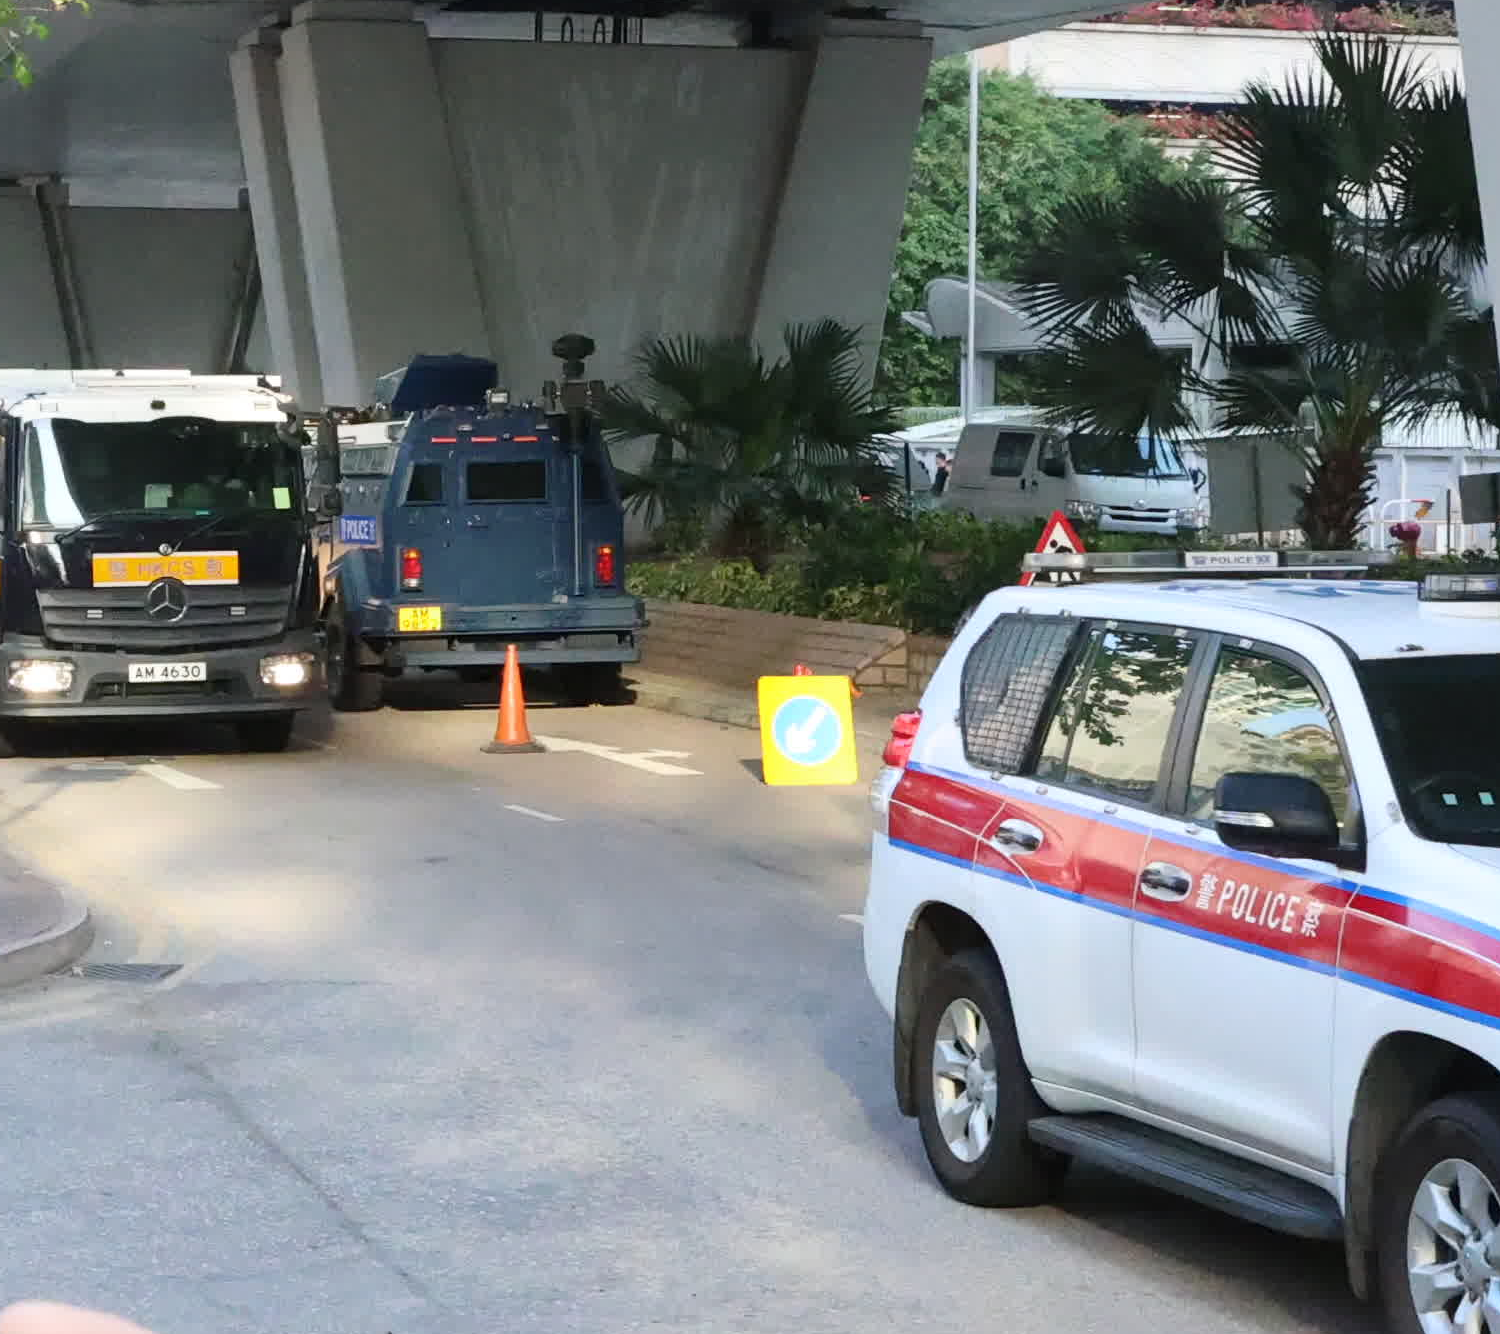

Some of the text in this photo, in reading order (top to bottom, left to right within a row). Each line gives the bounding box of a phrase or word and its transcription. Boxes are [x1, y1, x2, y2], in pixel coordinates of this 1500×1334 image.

[1209, 555, 1254, 565] POLICE
[135, 665, 201, 679] AM 4630
[1215, 878, 1303, 934] POLICE
